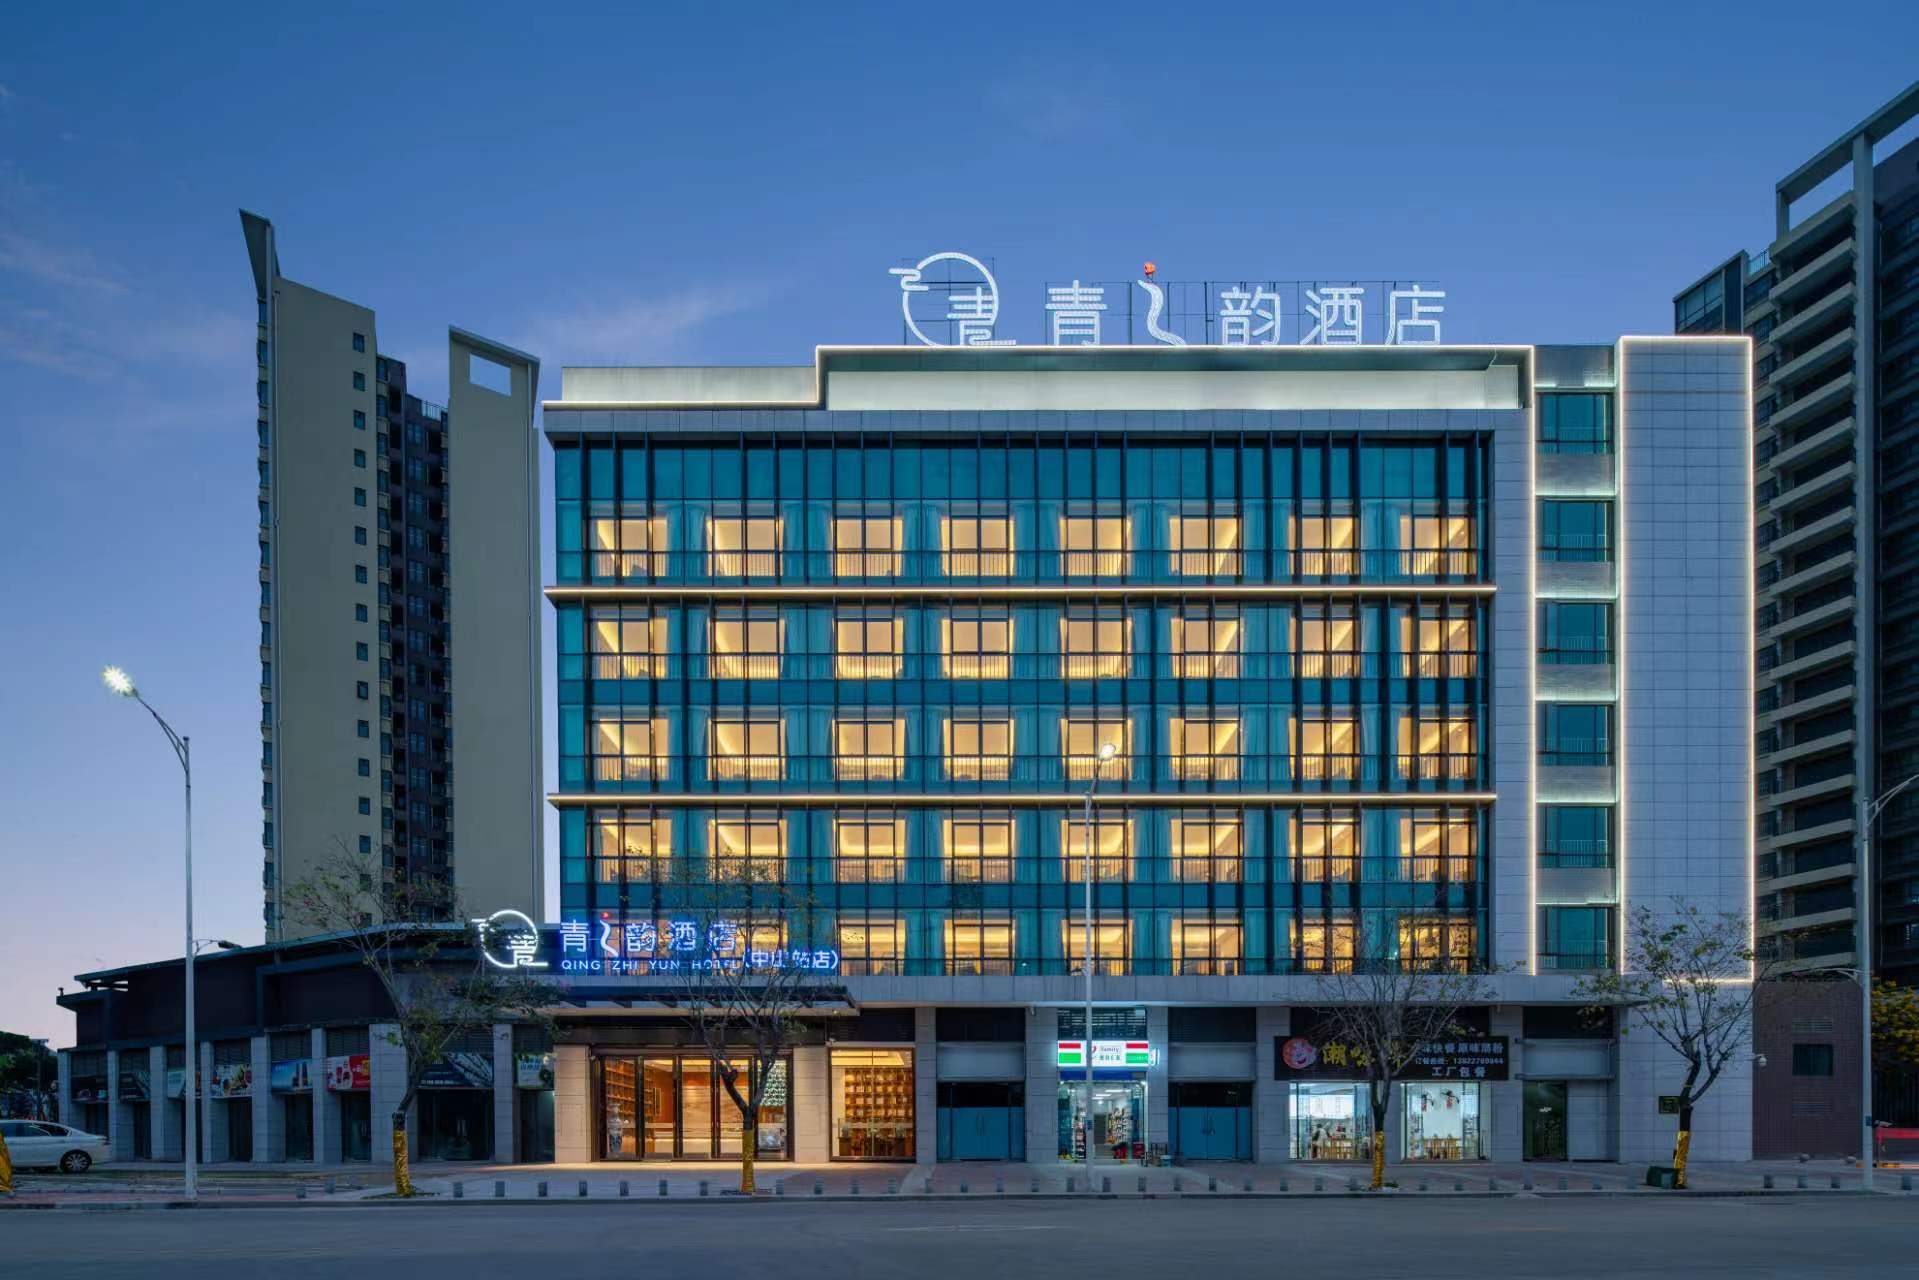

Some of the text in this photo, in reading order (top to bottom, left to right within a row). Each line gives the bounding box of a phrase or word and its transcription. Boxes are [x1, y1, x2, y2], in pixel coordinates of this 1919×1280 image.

[561, 960, 601, 970] QING
[611, 960, 638, 970] ZHI
[649, 960, 680, 970] YUN
[1431, 1066, 1486, 1078] 工厂包餐
